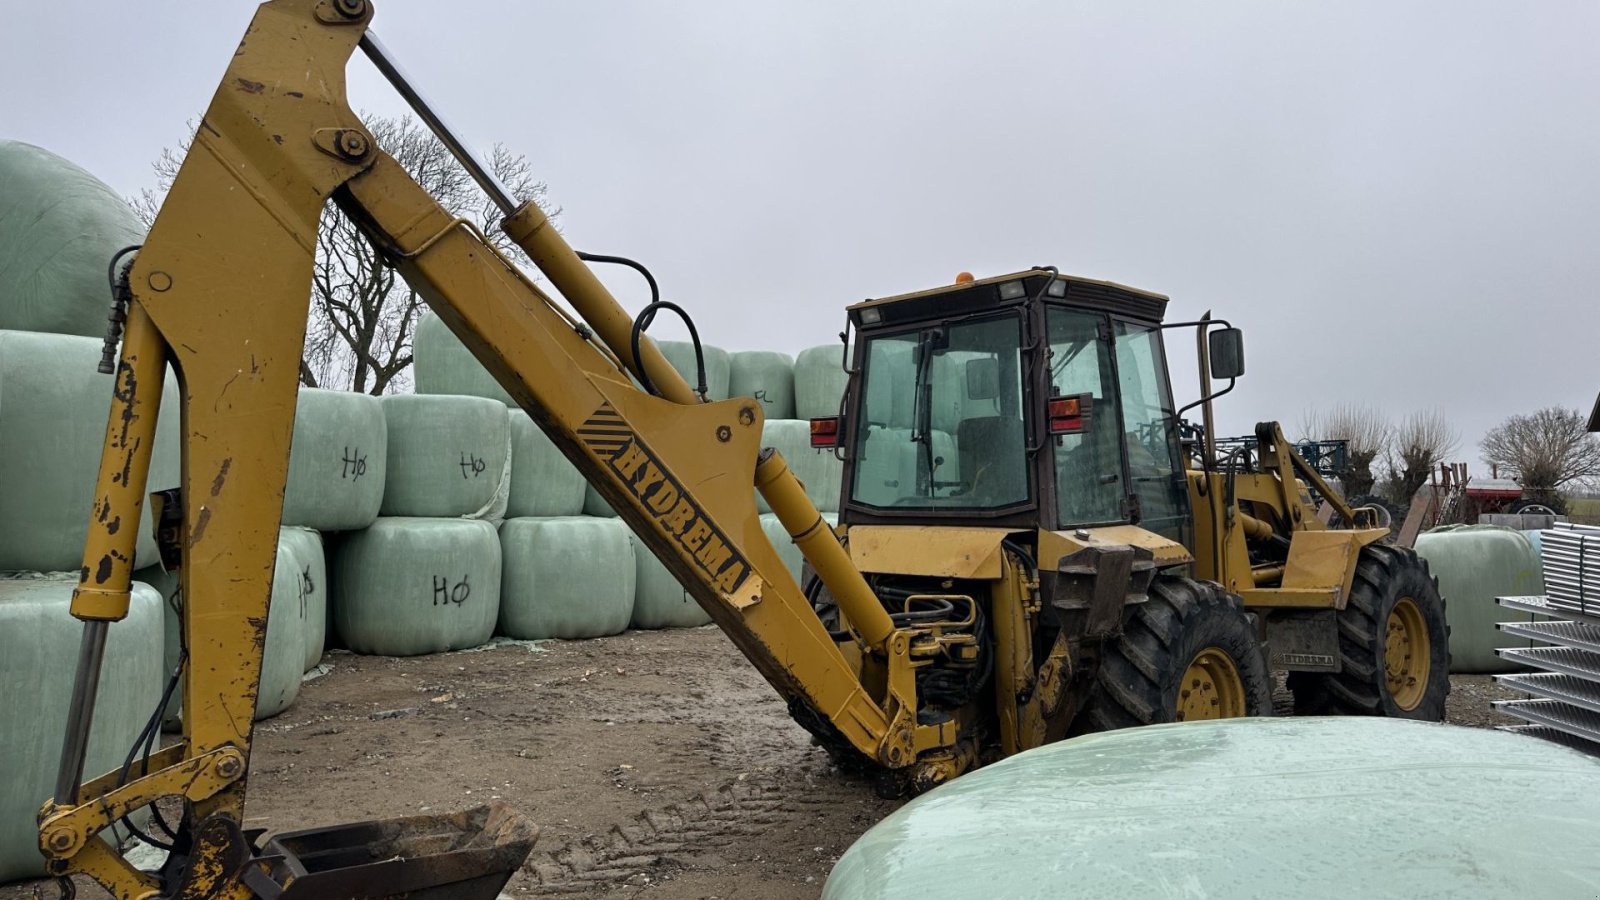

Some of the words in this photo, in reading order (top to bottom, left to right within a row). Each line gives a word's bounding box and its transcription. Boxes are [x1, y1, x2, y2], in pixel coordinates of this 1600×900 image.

[611, 439, 746, 595] HYDREMA
[433, 574, 470, 608] HØ
[1283, 654, 1334, 666] HYDREMA
